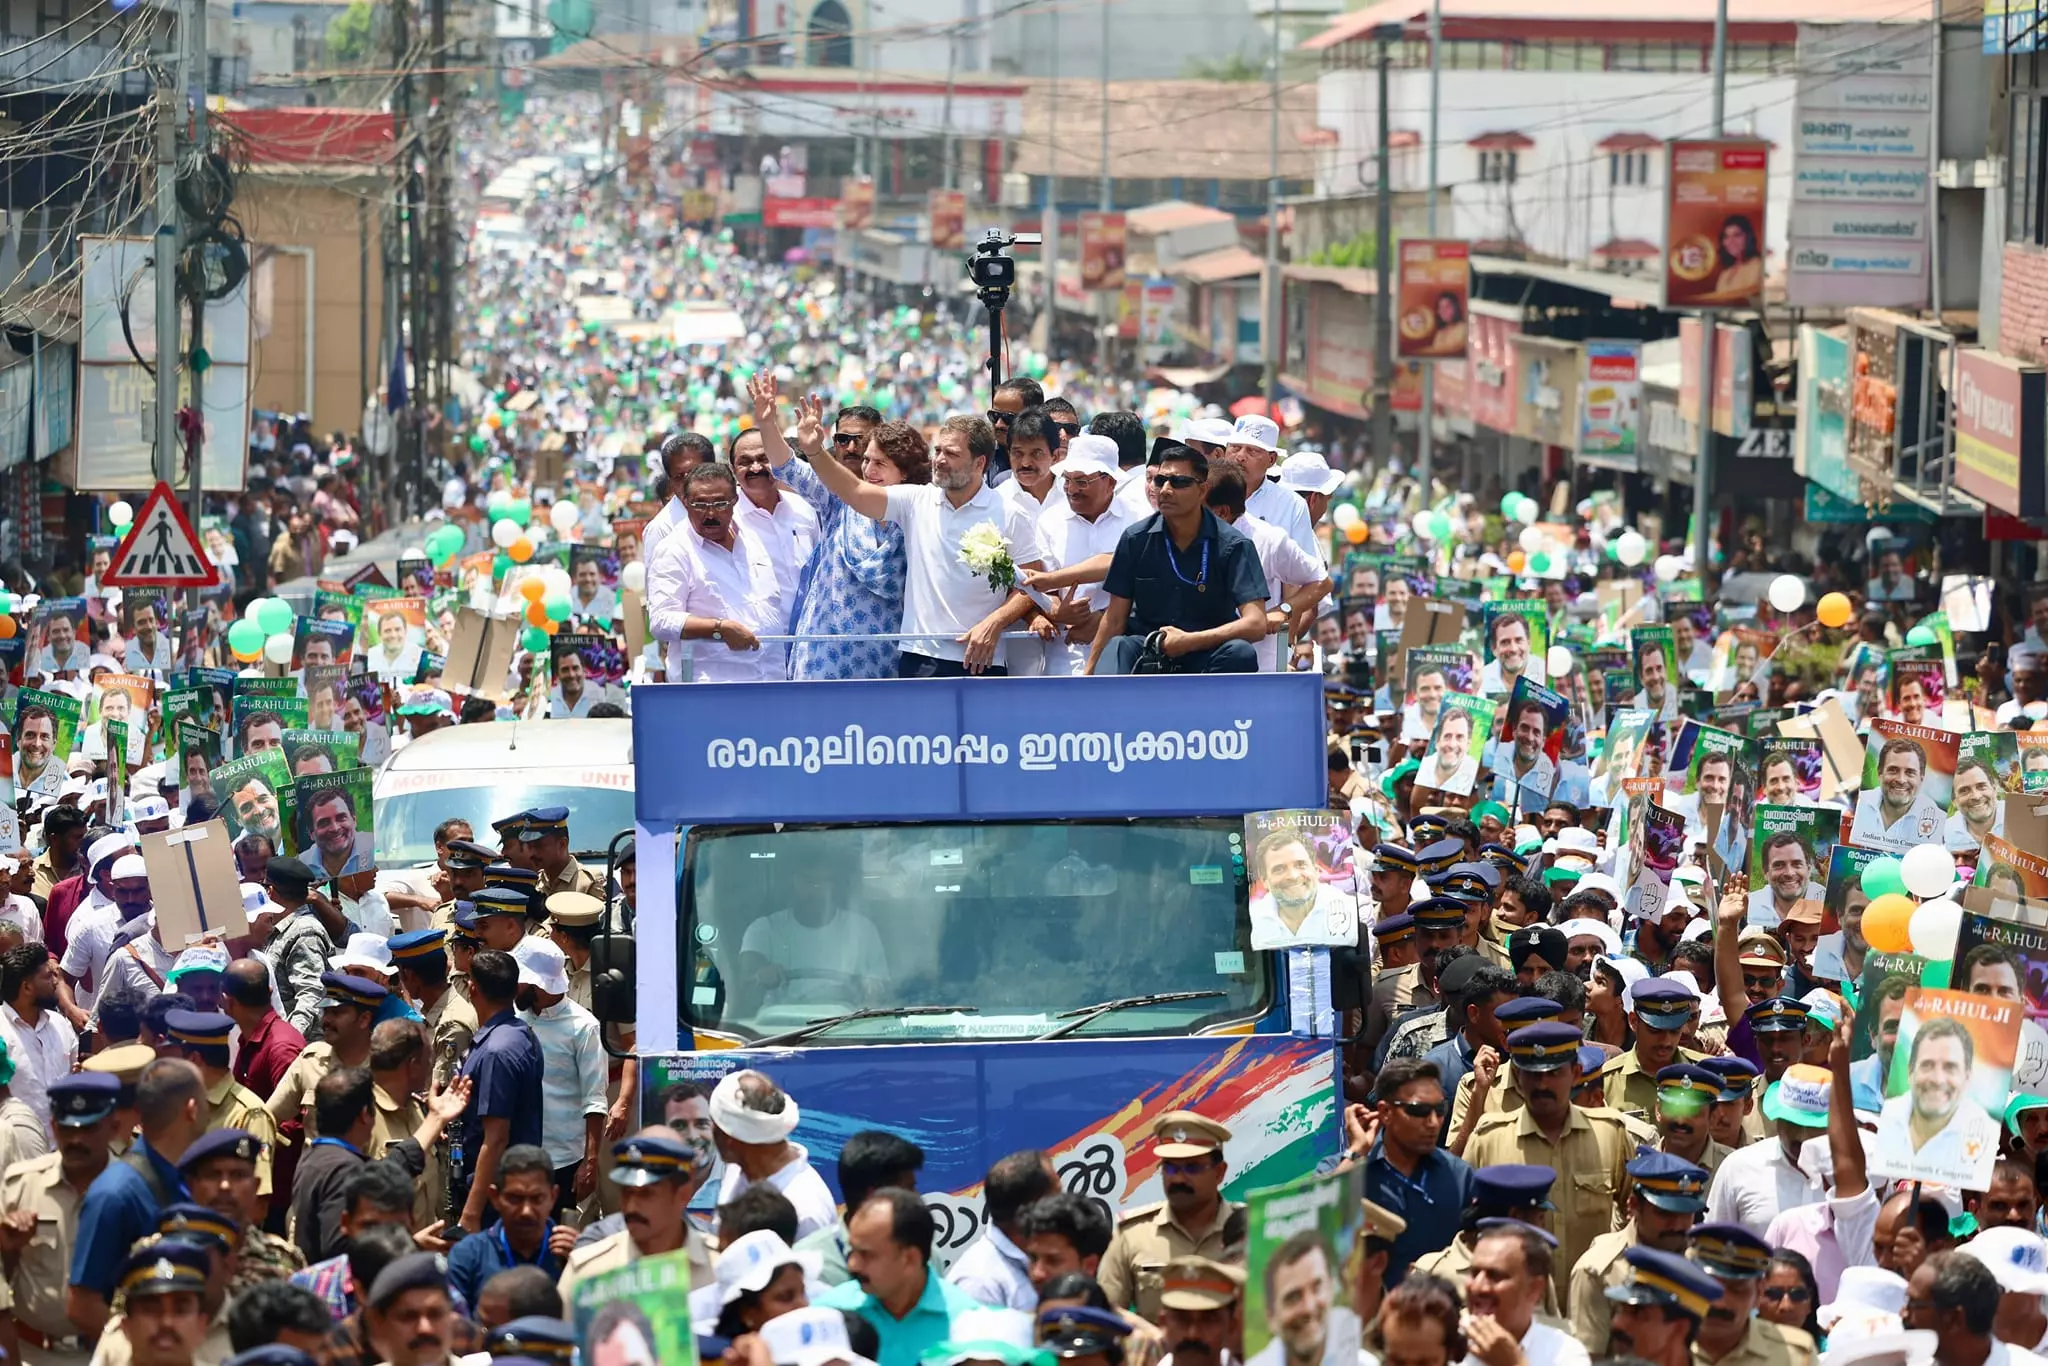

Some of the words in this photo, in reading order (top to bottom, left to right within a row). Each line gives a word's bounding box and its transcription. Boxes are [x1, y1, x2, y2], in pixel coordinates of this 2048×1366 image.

[252, 681, 286, 689] RAHUL
[34, 694, 67, 709] RAHUL
[254, 699, 292, 710] RAHUL
[293, 699, 302, 710] JI
[302, 733, 340, 745] RAHUL
[341, 734, 352, 745] JI
[1895, 723, 1940, 742] RAHUL
[1941, 732, 1952, 744] JI
[707, 724, 1009, 774] രാഹുലിനൊപ്പം
[1019, 719, 1253, 773] ഇന്ത്യക്കായ്
[1775, 742, 1806, 750] RAHUL
[1807, 742, 1815, 751] JI
[229, 756, 265, 776] RAHUL
[267, 752, 277, 763] JI
[316, 775, 355, 788] RAHUL
[357, 772, 366, 783] JI
[581, 772, 630, 786] UNIT
[1257, 818, 1268, 830] vote
[1268, 818, 1277, 830] for
[1276, 815, 1328, 828] RAHUL
[1329, 815, 1340, 827] JI
[1763, 809, 1815, 825] വയനാടിന്റെ
[1763, 820, 1797, 832] രാഹുൽ
[1862, 831, 1881, 841] Indian
[1882, 834, 1900, 845] Youth
[2001, 847, 2037, 874] RAHUL
[1972, 921, 1982, 935] vote
[1982, 923, 1993, 939] for
[1991, 926, 2045, 949] RAHUL
[1873, 954, 1885, 968] vote
[1894, 959, 1926, 976] RAH
[1931, 996, 1991, 1020] RAHUL
[1993, 1007, 2011, 1024] JI
[658, 1056, 736, 1070] രാഹുലിനൊപ്പം
